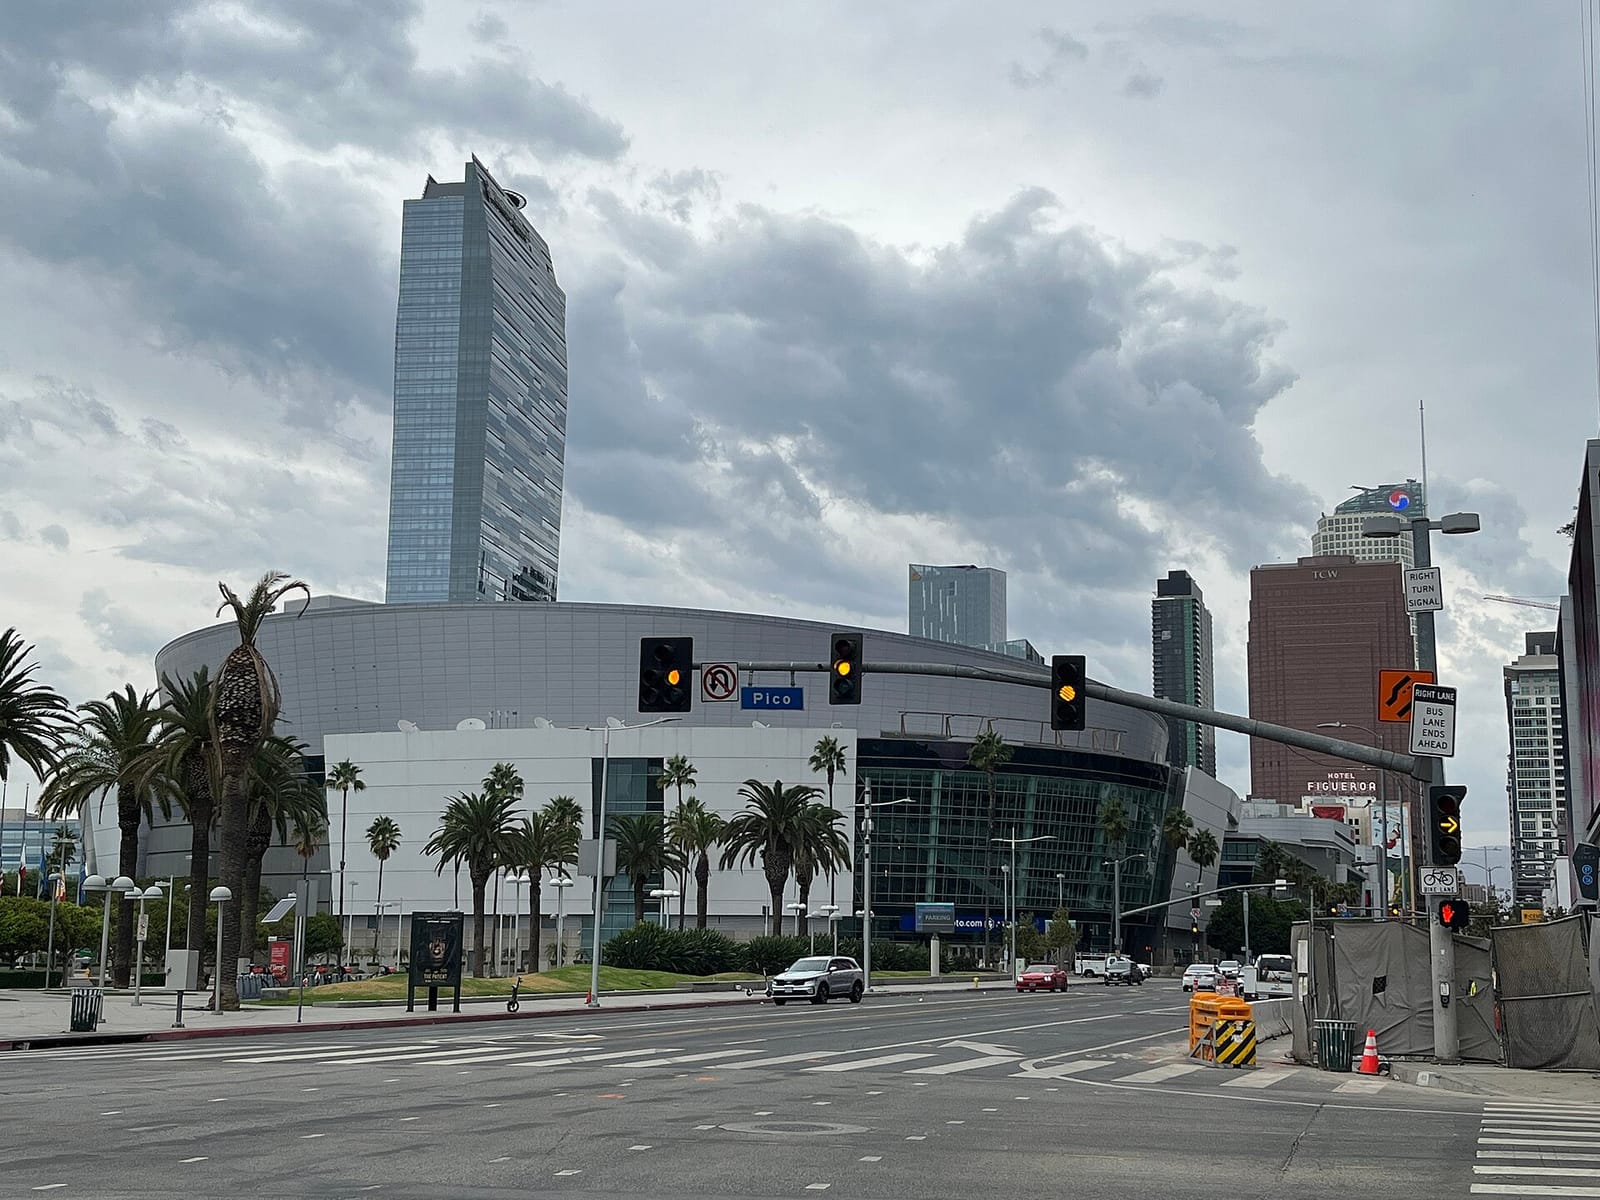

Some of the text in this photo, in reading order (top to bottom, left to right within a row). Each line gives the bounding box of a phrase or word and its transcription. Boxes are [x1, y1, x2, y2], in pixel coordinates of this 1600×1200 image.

[1312, 570, 1337, 579] TCW
[1410, 572, 1434, 581] RIGHT
[1412, 585, 1435, 593] TURN
[1409, 598, 1440, 607] SIGNAL
[753, 692, 791, 704] Pico
[1415, 689, 1455, 701] RIGHT LANE
[1426, 707, 1443, 716] BUS
[1423, 718, 1446, 727] LANE
[1423, 729, 1445, 738] ENDS
[1418, 739, 1447, 749] AHEAD
[1307, 782, 1376, 791] FIGUEROA
[953, 919, 983, 928] to.com
